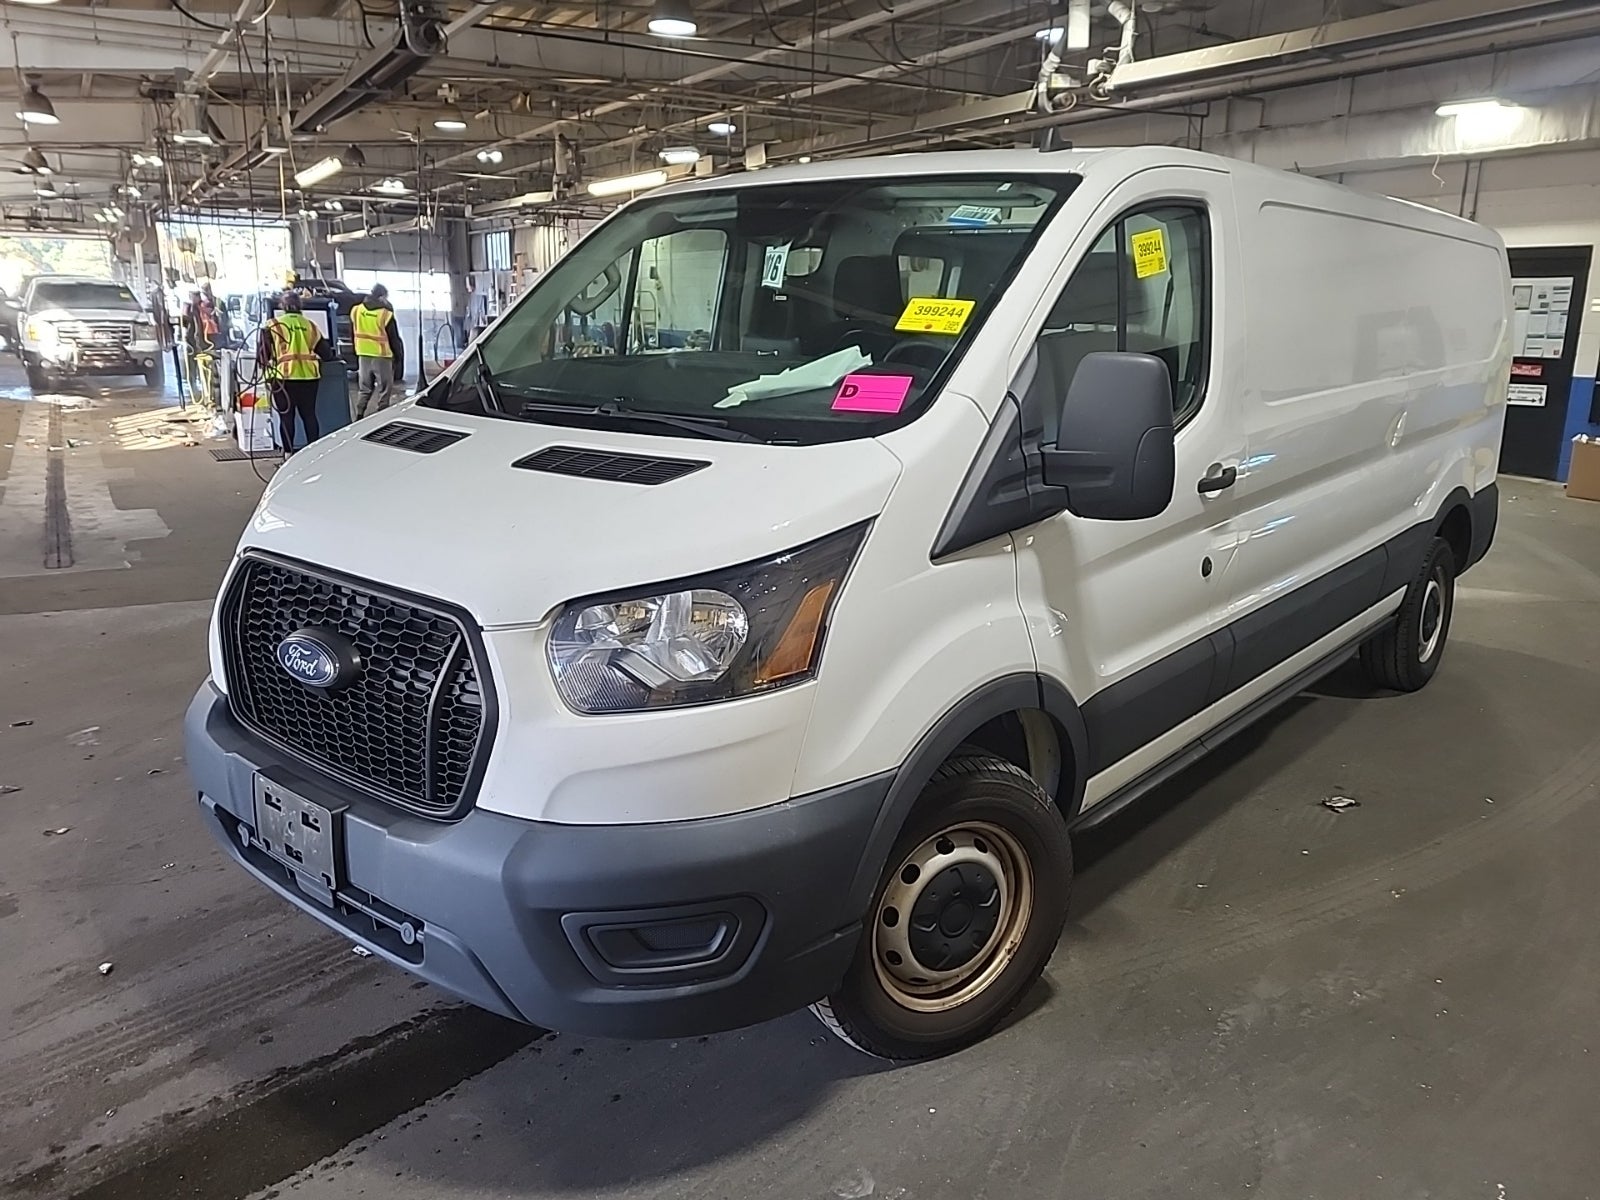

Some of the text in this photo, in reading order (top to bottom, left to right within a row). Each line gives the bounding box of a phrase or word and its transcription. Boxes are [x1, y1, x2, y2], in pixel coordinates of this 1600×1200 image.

[1138, 239, 1162, 258] 399244
[914, 305, 965, 318] 399244
[840, 384, 859, 398] D
[284, 643, 319, 677] Ford
